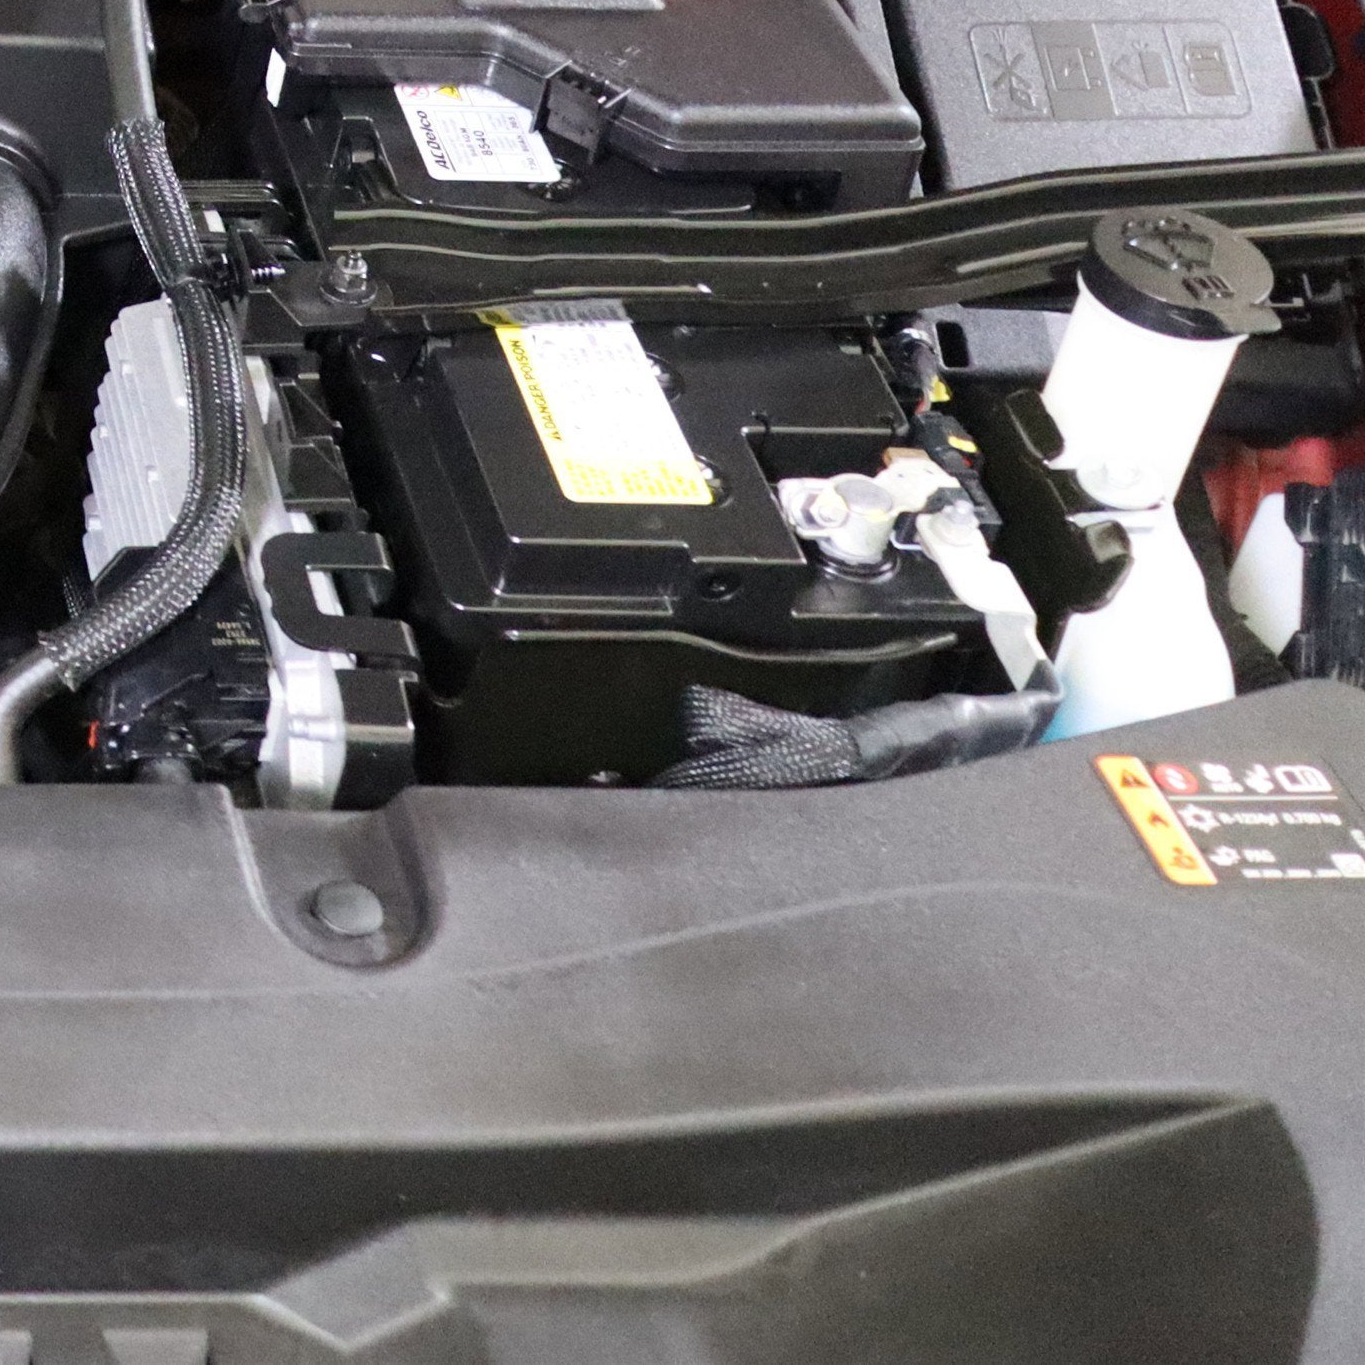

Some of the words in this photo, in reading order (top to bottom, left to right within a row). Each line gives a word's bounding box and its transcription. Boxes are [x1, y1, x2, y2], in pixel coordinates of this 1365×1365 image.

[416, 110, 450, 170] ACDelco
[508, 339, 537, 380] POISON
[528, 384, 558, 429] DANGER
